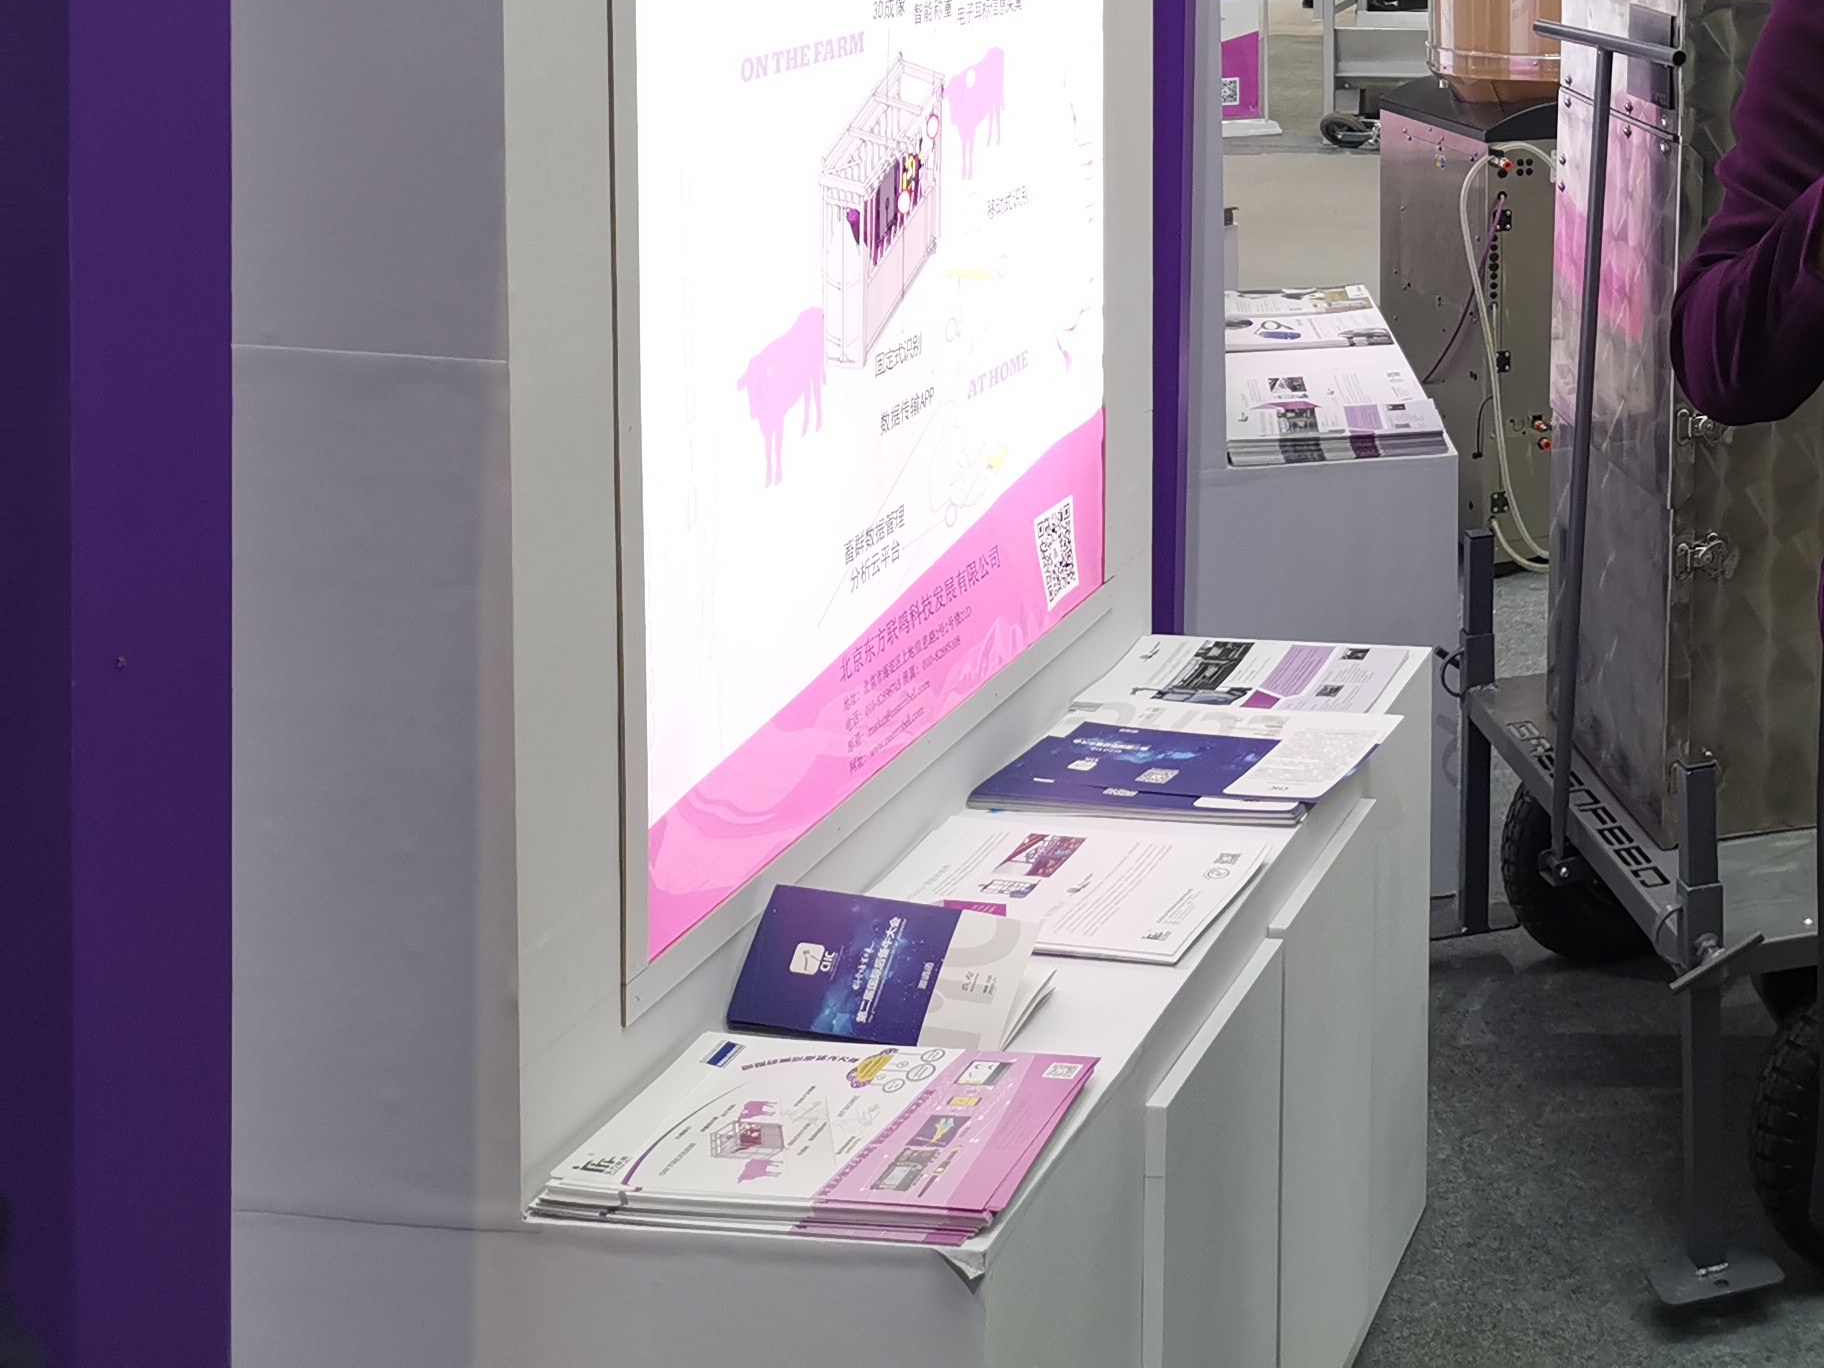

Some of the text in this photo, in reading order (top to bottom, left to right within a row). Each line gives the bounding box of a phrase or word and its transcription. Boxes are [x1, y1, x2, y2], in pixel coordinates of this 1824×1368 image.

[740, 31, 865, 82] ON THE FARM
[874, 333, 922, 378] 固定式识别
[967, 351, 1030, 400] AT HOME
[880, 386, 935, 436] 数据传输APP
[849, 540, 901, 593] 分析云平台
[838, 545, 1002, 683] 北京东方联鸣科技发展有限公司
